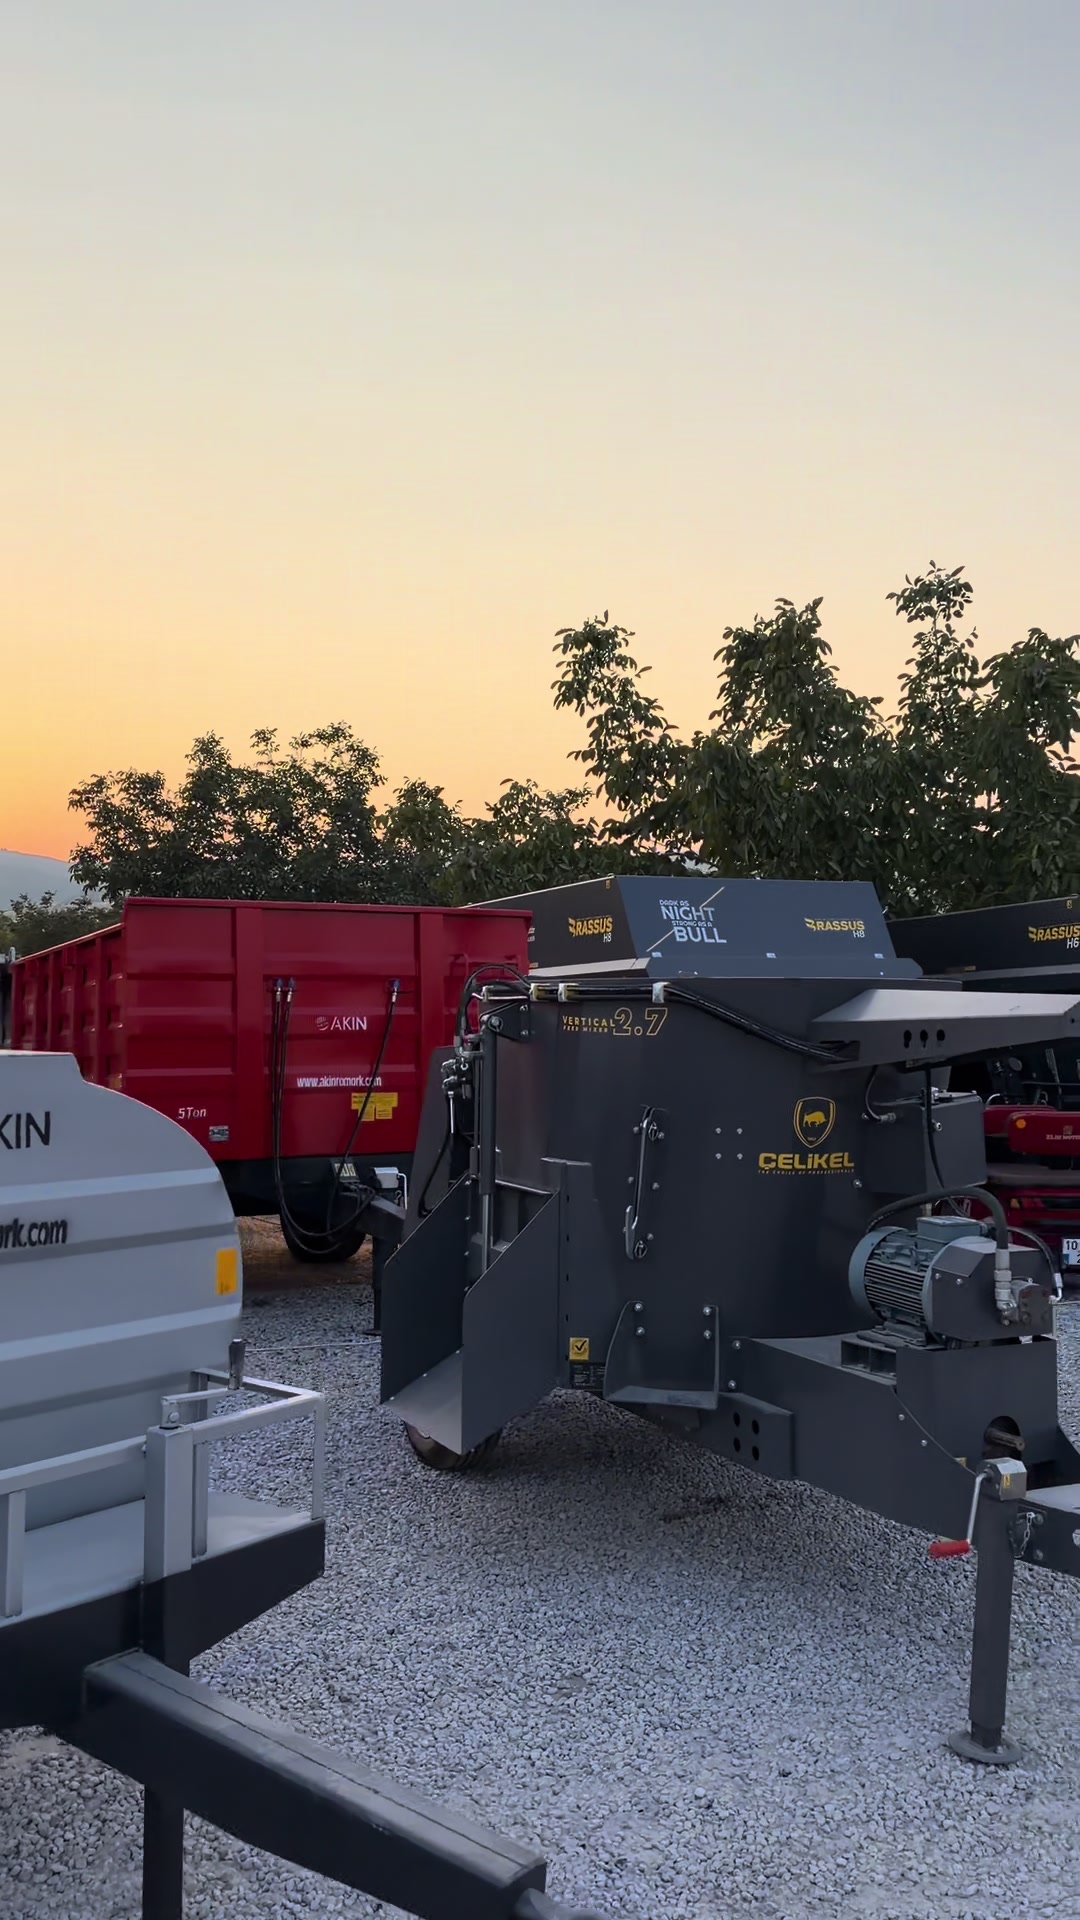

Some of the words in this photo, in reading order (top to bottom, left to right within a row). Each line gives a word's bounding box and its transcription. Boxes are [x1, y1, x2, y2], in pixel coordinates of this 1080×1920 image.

[660, 905, 715, 921] NIGHT
[603, 932, 612, 943] H8
[673, 926, 728, 944] BULL
[852, 930, 866, 938] H8
[1066, 937, 1080, 949] H6
[330, 1016, 367, 1031] AKIN
[562, 1015, 616, 1027] VERTICAL
[613, 1007, 669, 1036] 2.7
[1065, 1240, 1078, 1251] 10
